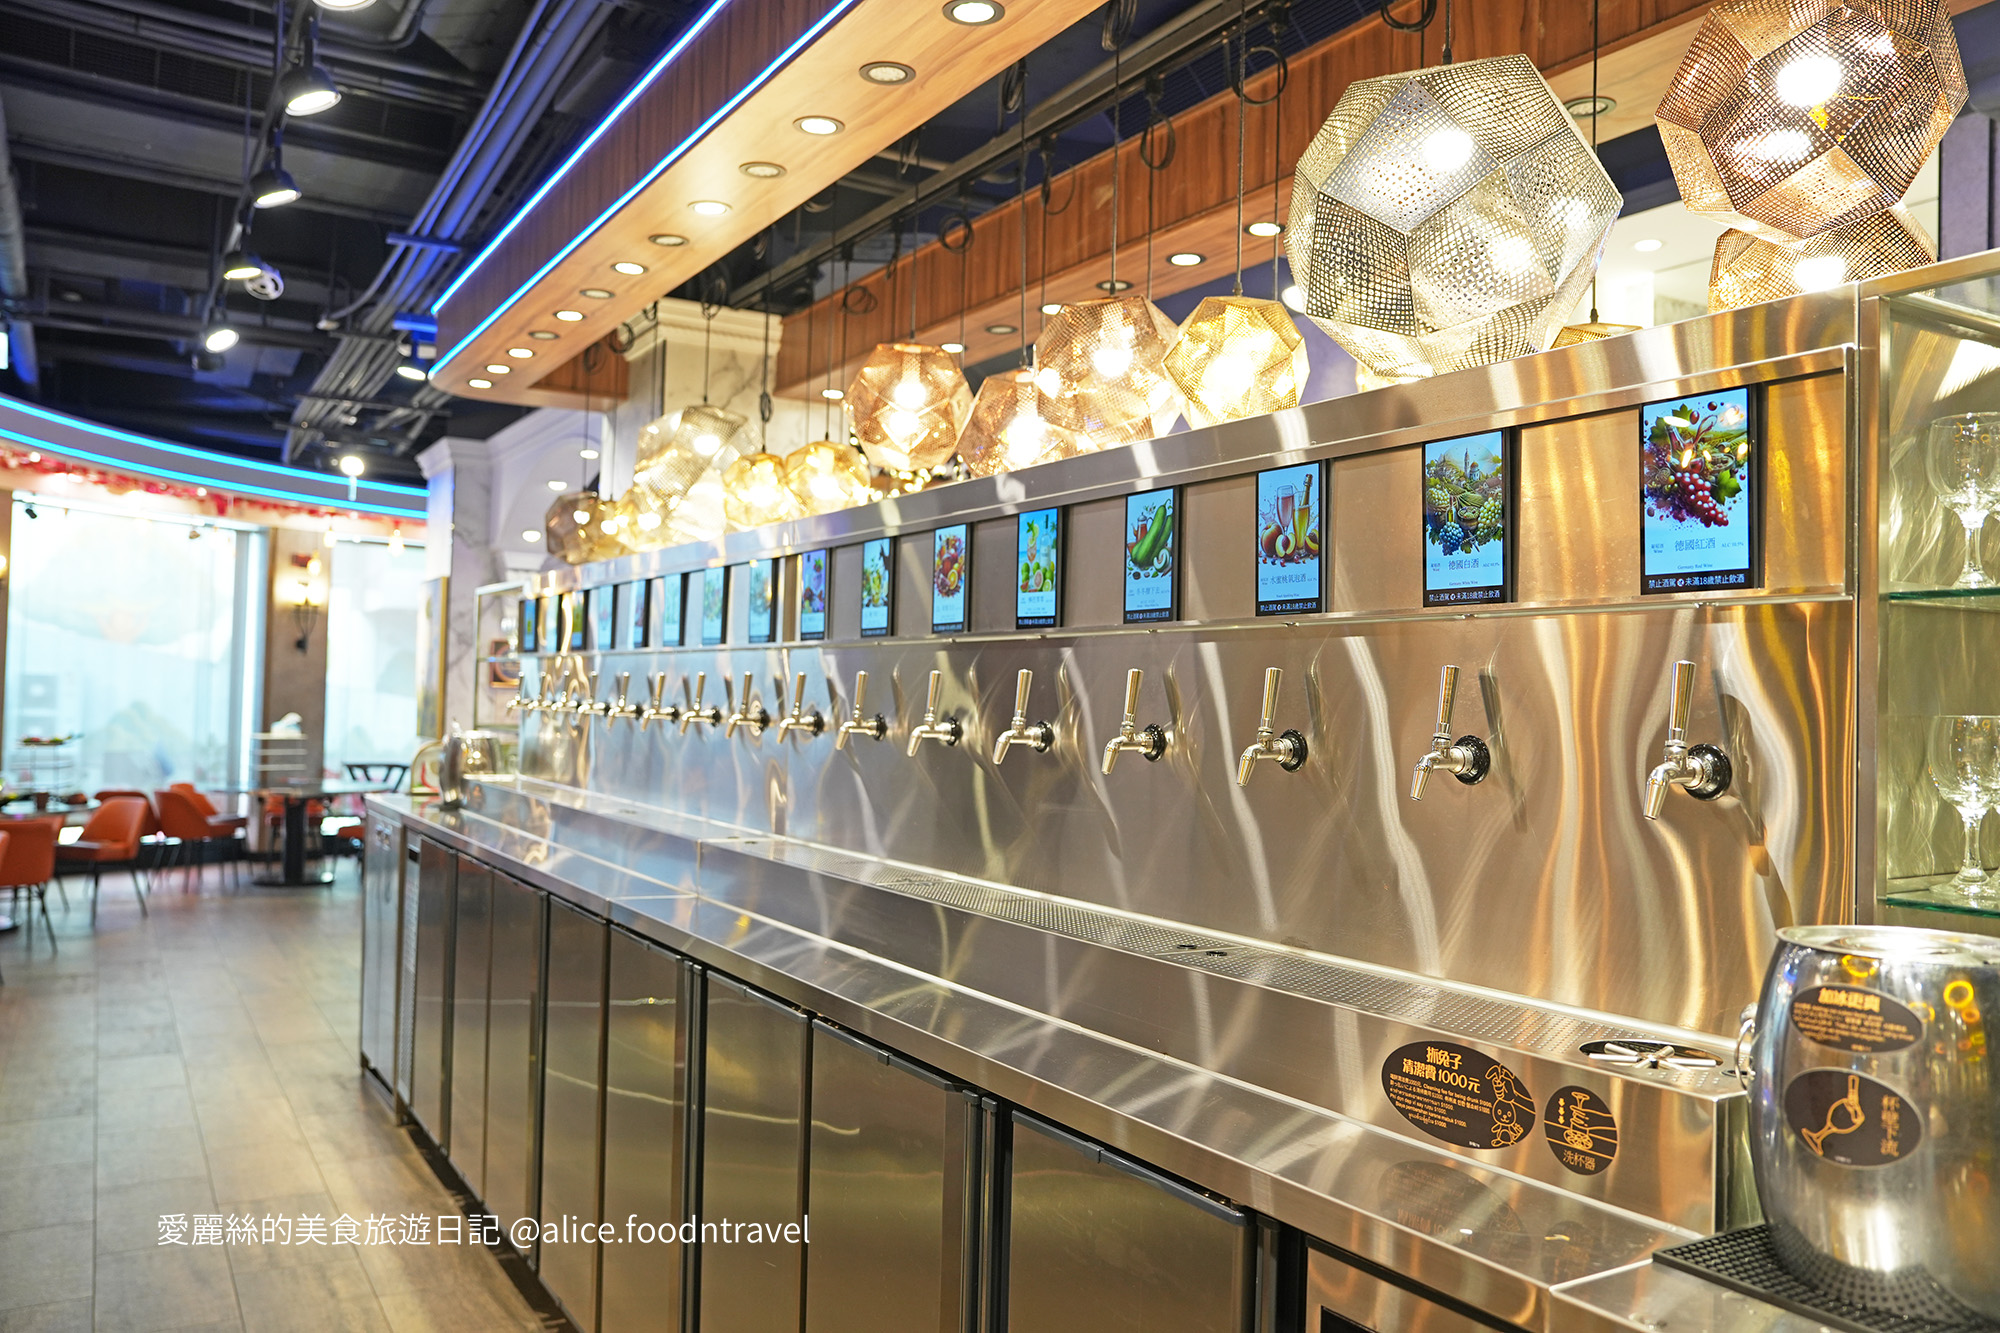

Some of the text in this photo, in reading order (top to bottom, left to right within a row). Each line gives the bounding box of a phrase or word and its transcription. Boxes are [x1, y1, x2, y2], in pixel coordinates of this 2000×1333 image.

[1675, 537, 1716, 552] 德國紅酒
[1426, 1046, 1462, 1070] 抓兔子
[1563, 1149, 1595, 1171] 洗杯器
